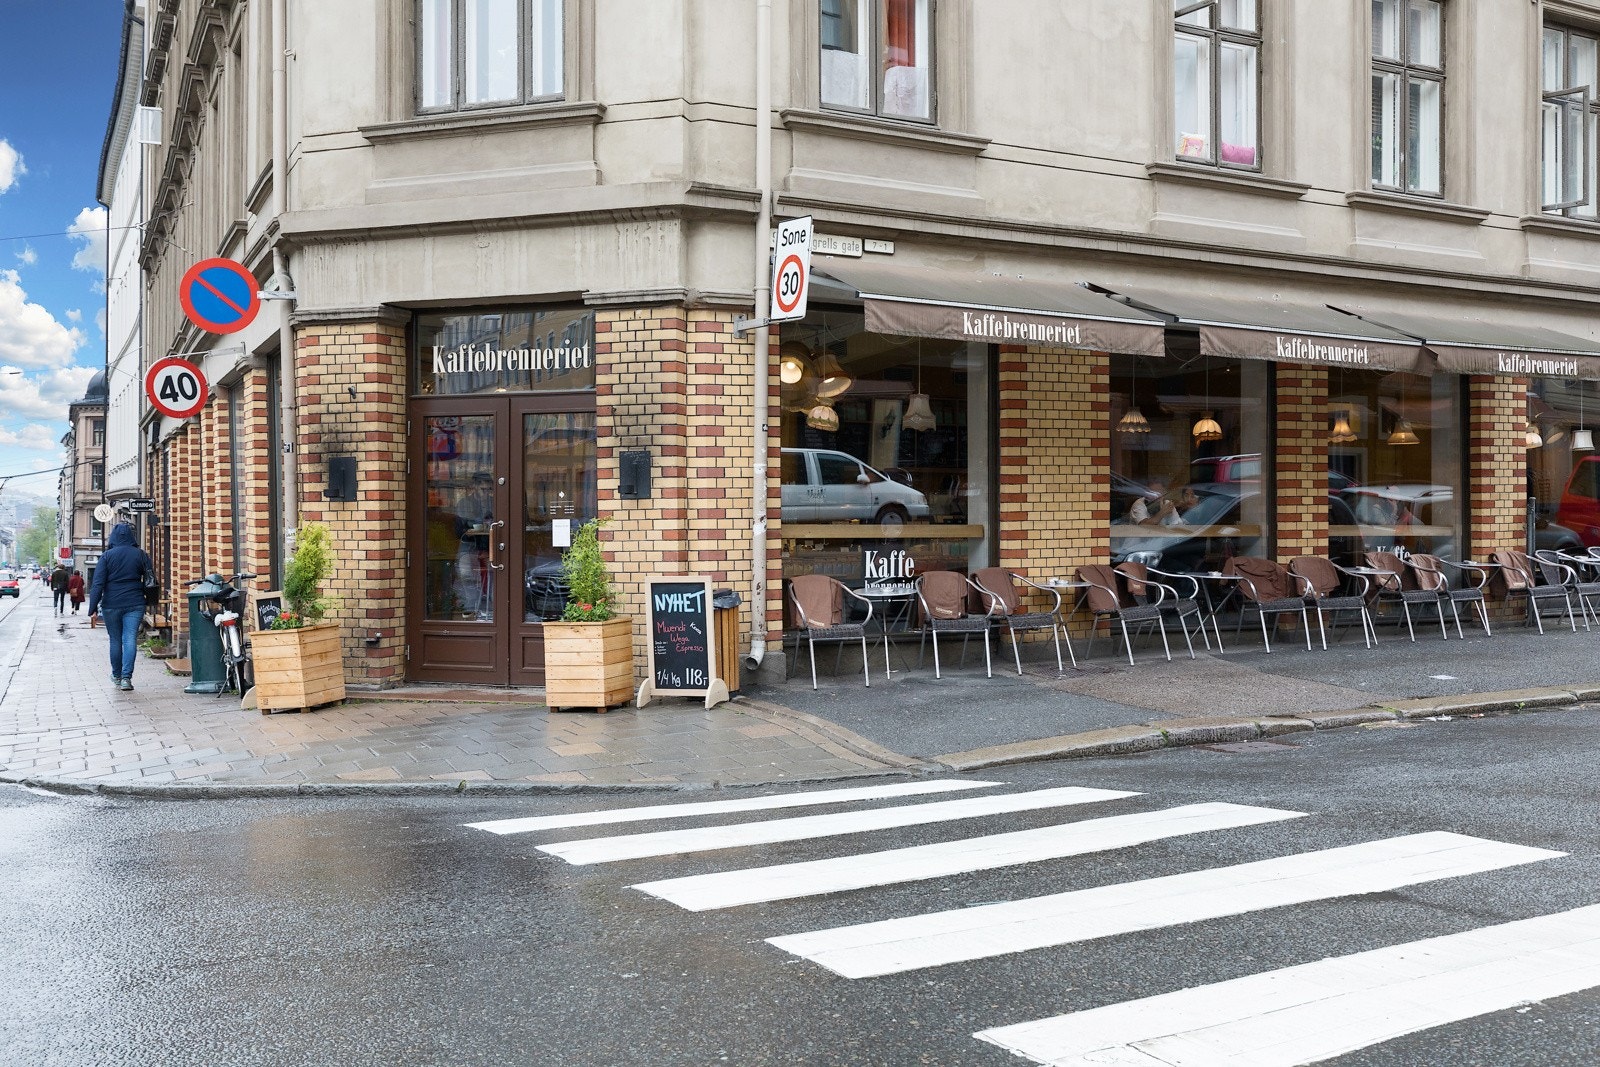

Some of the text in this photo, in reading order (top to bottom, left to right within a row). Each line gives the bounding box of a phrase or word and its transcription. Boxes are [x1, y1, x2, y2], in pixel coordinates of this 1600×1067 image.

[781, 228, 806, 247] Sone
[812, 238, 860, 253] grells gate
[781, 271, 799, 296] 30
[962, 312, 1082, 344] Kaffebrenneriet
[432, 339, 592, 374] Kaffebrenneriet
[1276, 336, 1369, 364] Kaffebrenneriet
[1498, 353, 1578, 376] Kaffebrenneriet
[160, 372, 198, 402] 40
[864, 550, 915, 578] Kaffe
[654, 590, 705, 613] NYHET
[657, 621, 686, 633] Mwendi
[670, 633, 690, 645] Wega
[675, 643, 704, 654] Espresso
[657, 669, 669, 685] 1/4
